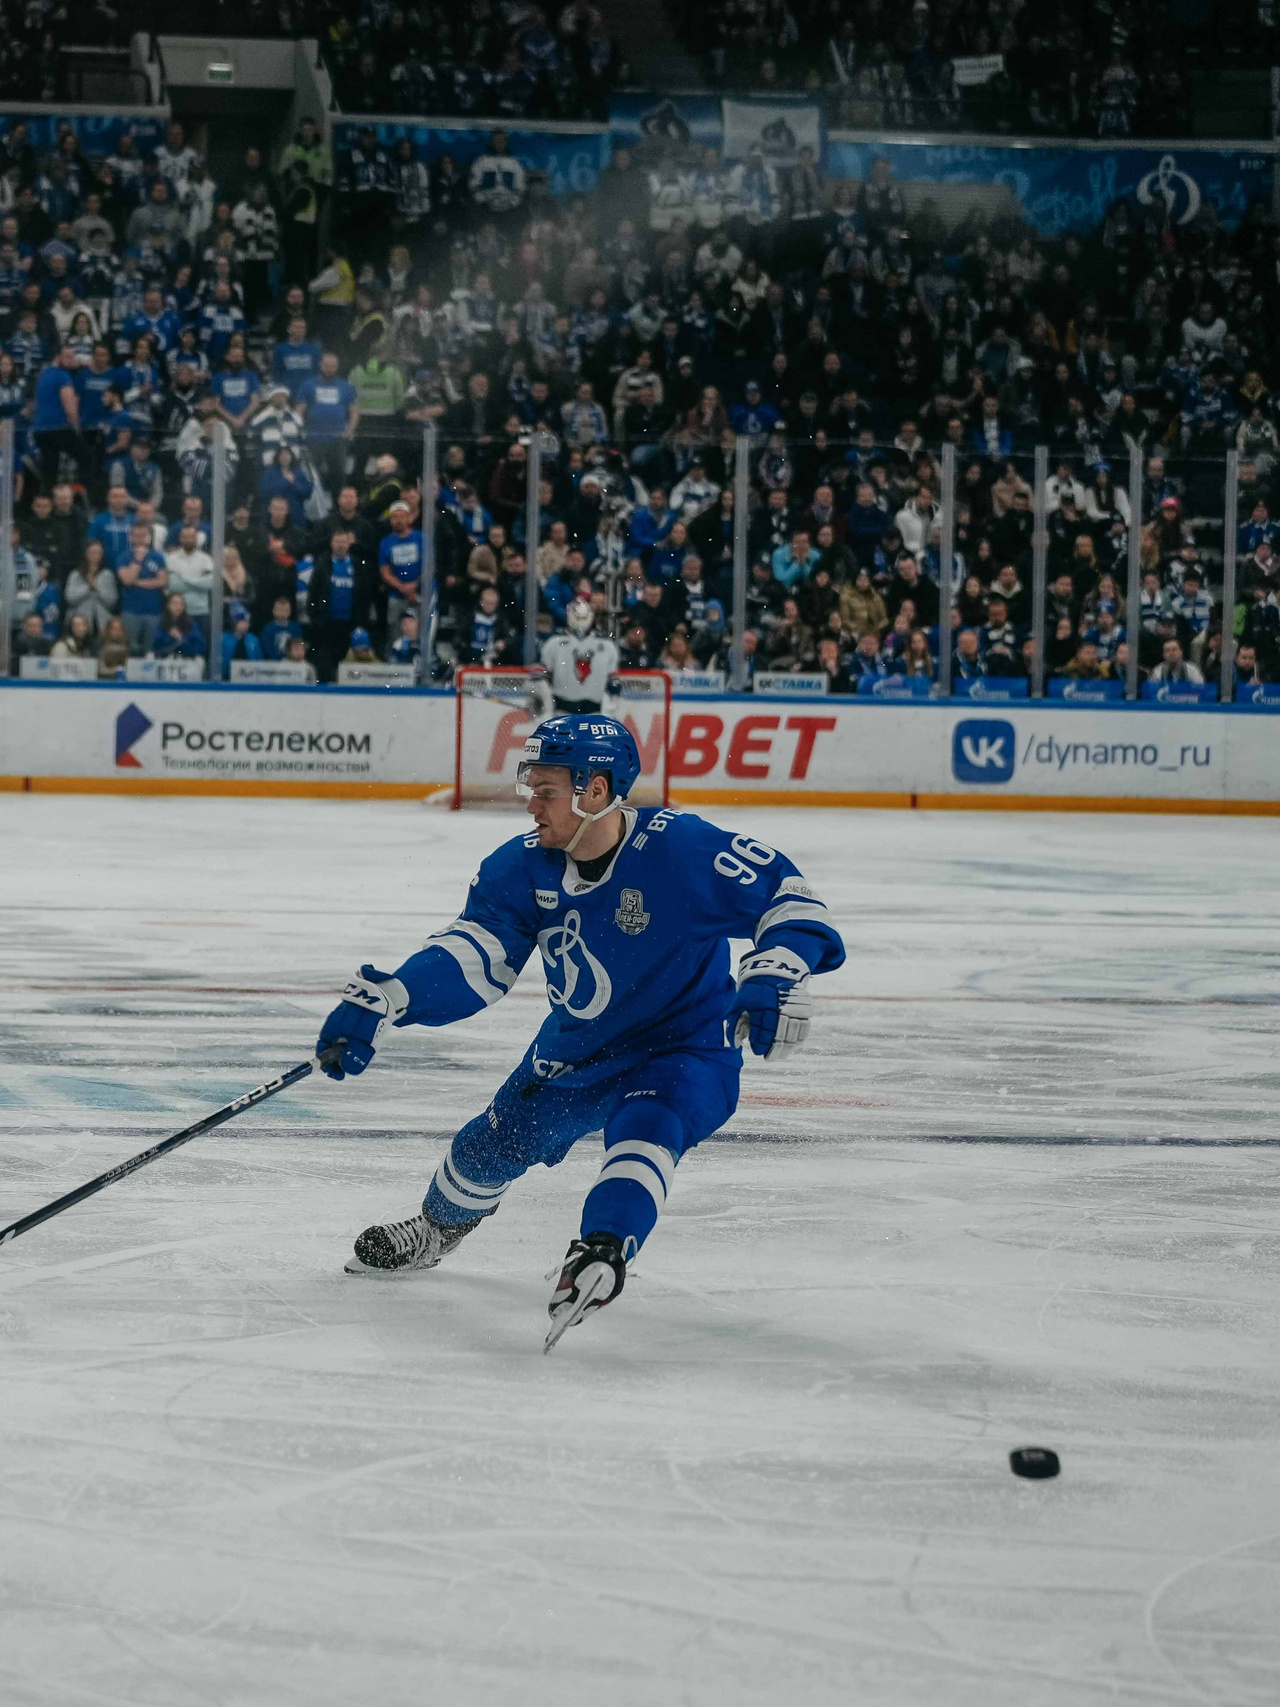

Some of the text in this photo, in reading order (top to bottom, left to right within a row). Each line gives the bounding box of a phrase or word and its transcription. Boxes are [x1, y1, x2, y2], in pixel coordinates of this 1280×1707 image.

[161, 721, 371, 754] Ростелеком
[486, 709, 837, 780] FNBET
[961, 734, 1211, 773] VK /dynamo_ru
[587, 755, 615, 763] CCM
[713, 833, 777, 886] 96
[535, 893, 557, 904] МИР
